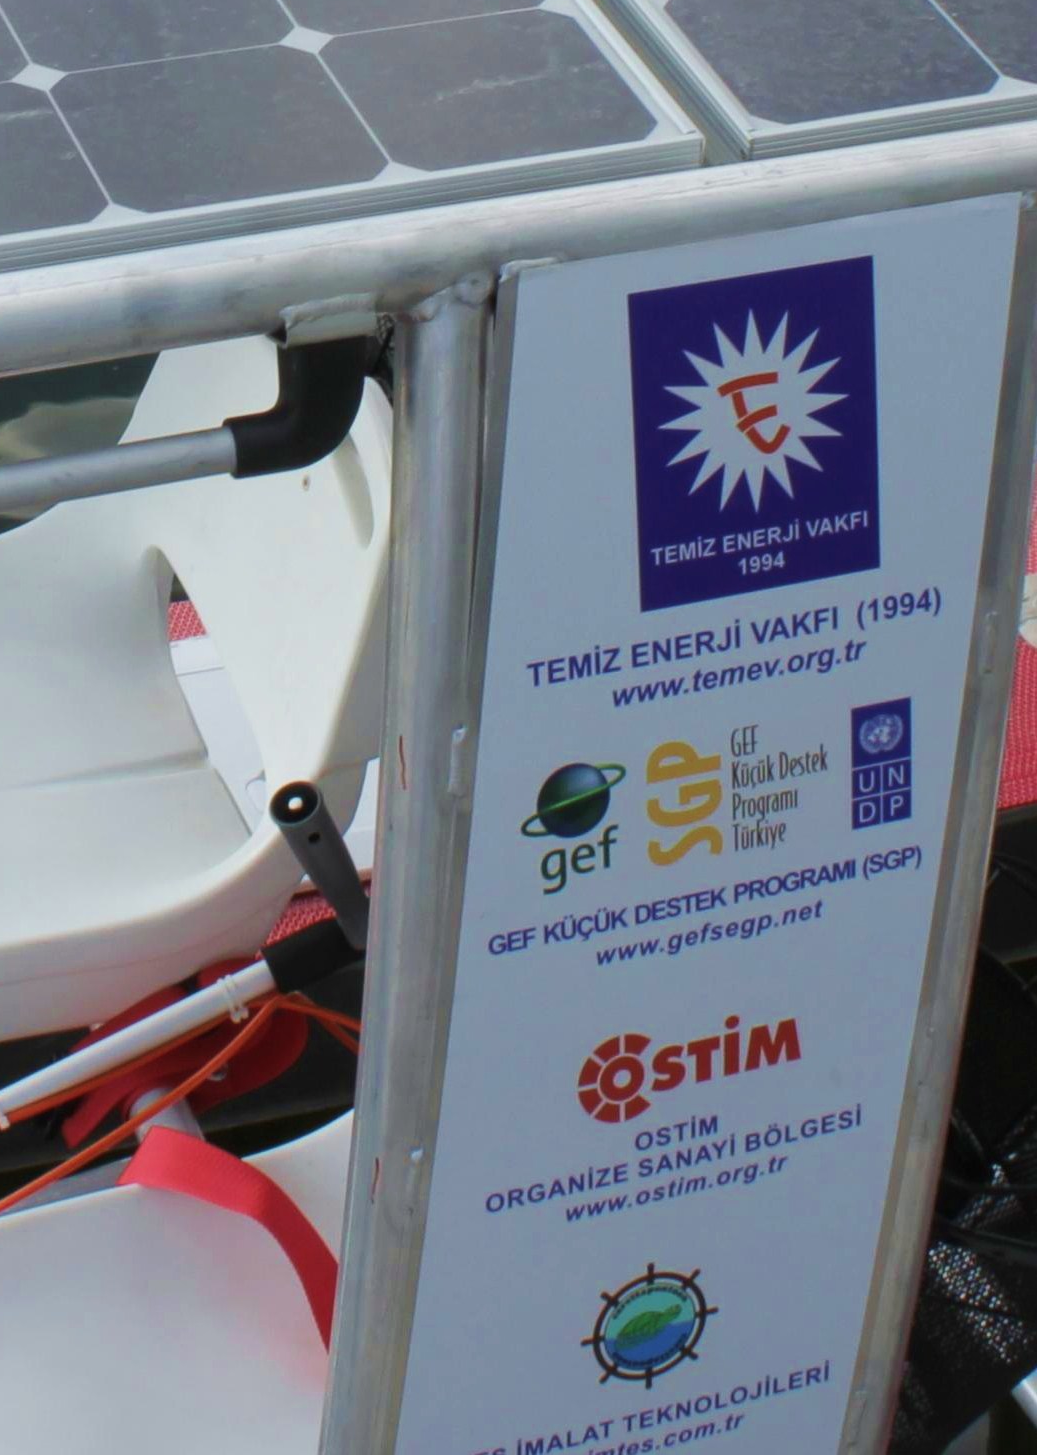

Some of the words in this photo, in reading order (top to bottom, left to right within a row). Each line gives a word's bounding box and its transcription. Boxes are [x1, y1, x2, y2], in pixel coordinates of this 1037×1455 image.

[651, 536, 716, 566] TEMİZ
[723, 519, 800, 553] ENERJİ
[806, 509, 868, 538] VAKFI
[738, 551, 786, 576] 1994
[527, 644, 622, 687] TEMİZ
[631, 618, 743, 668] ENERJİ
[750, 605, 838, 645] VAKFI
[857, 587, 941, 630] (1994)
[612, 638, 866, 707] www.temev.org.tr
[730, 724, 759, 757] GEF
[731, 754, 775, 789] Küçük
[779, 743, 828, 780] Destek
[646, 741, 723, 866] SGP
[731, 789, 799, 821] Programı
[731, 818, 787, 852] Türkiye
[540, 825, 619, 894] gef
[488, 926, 536, 956] GEF
[543, 906, 628, 941] KÜÇÜK
[634, 886, 727, 925] DESTEK
[733, 859, 856, 904] PROGRAMI
[862, 845, 923, 881] (SGP)
[596, 899, 823, 966] www.gefsegp.net
[577, 1014, 802, 1124] OSTİM
[485, 1160, 629, 1214] ORGANİZE
[637, 1138, 736, 1179] SANAYİ
[744, 1103, 862, 1154] BÖLGESİ
[634, 1115, 719, 1152] OSTİM
[564, 1153, 788, 1223] www.ostim.org.tr
[516, 1420, 615, 1455] İMALAT
[622, 1360, 830, 1433] TEKNOLOJİLERİ
